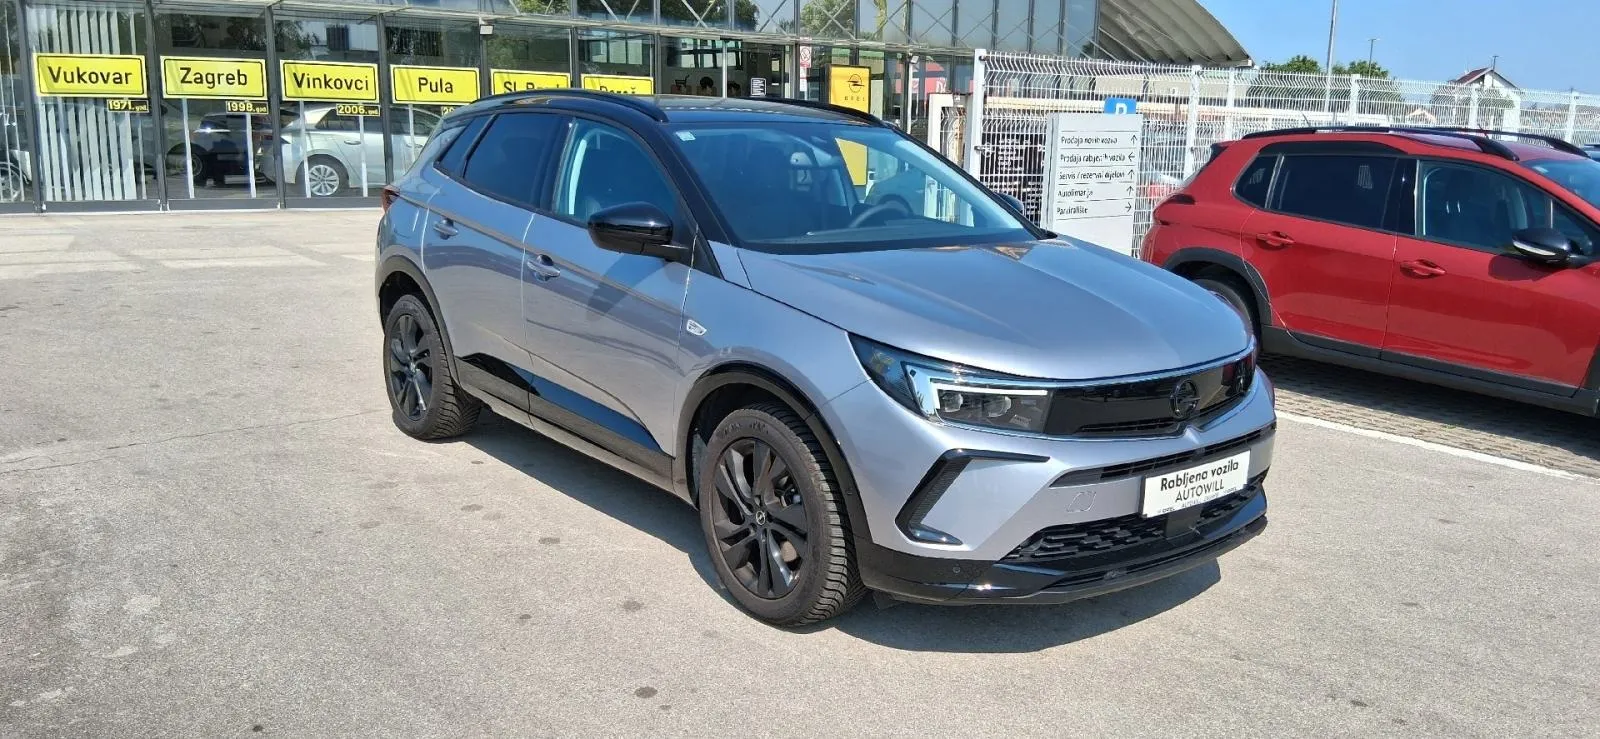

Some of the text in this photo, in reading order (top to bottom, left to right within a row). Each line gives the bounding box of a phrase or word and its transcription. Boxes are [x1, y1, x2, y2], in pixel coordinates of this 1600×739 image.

[48, 66, 132, 84] Vukovar
[180, 67, 248, 89] Zagreb
[293, 72, 369, 91] Vinkovci
[418, 77, 453, 93] Pula
[109, 100, 135, 110] 1971.
[227, 102, 255, 112] 1998.
[338, 105, 367, 115] 2006.
[1160, 459, 1239, 491] Rabljena vozila
[1175, 479, 1225, 502] AUTOWILL
